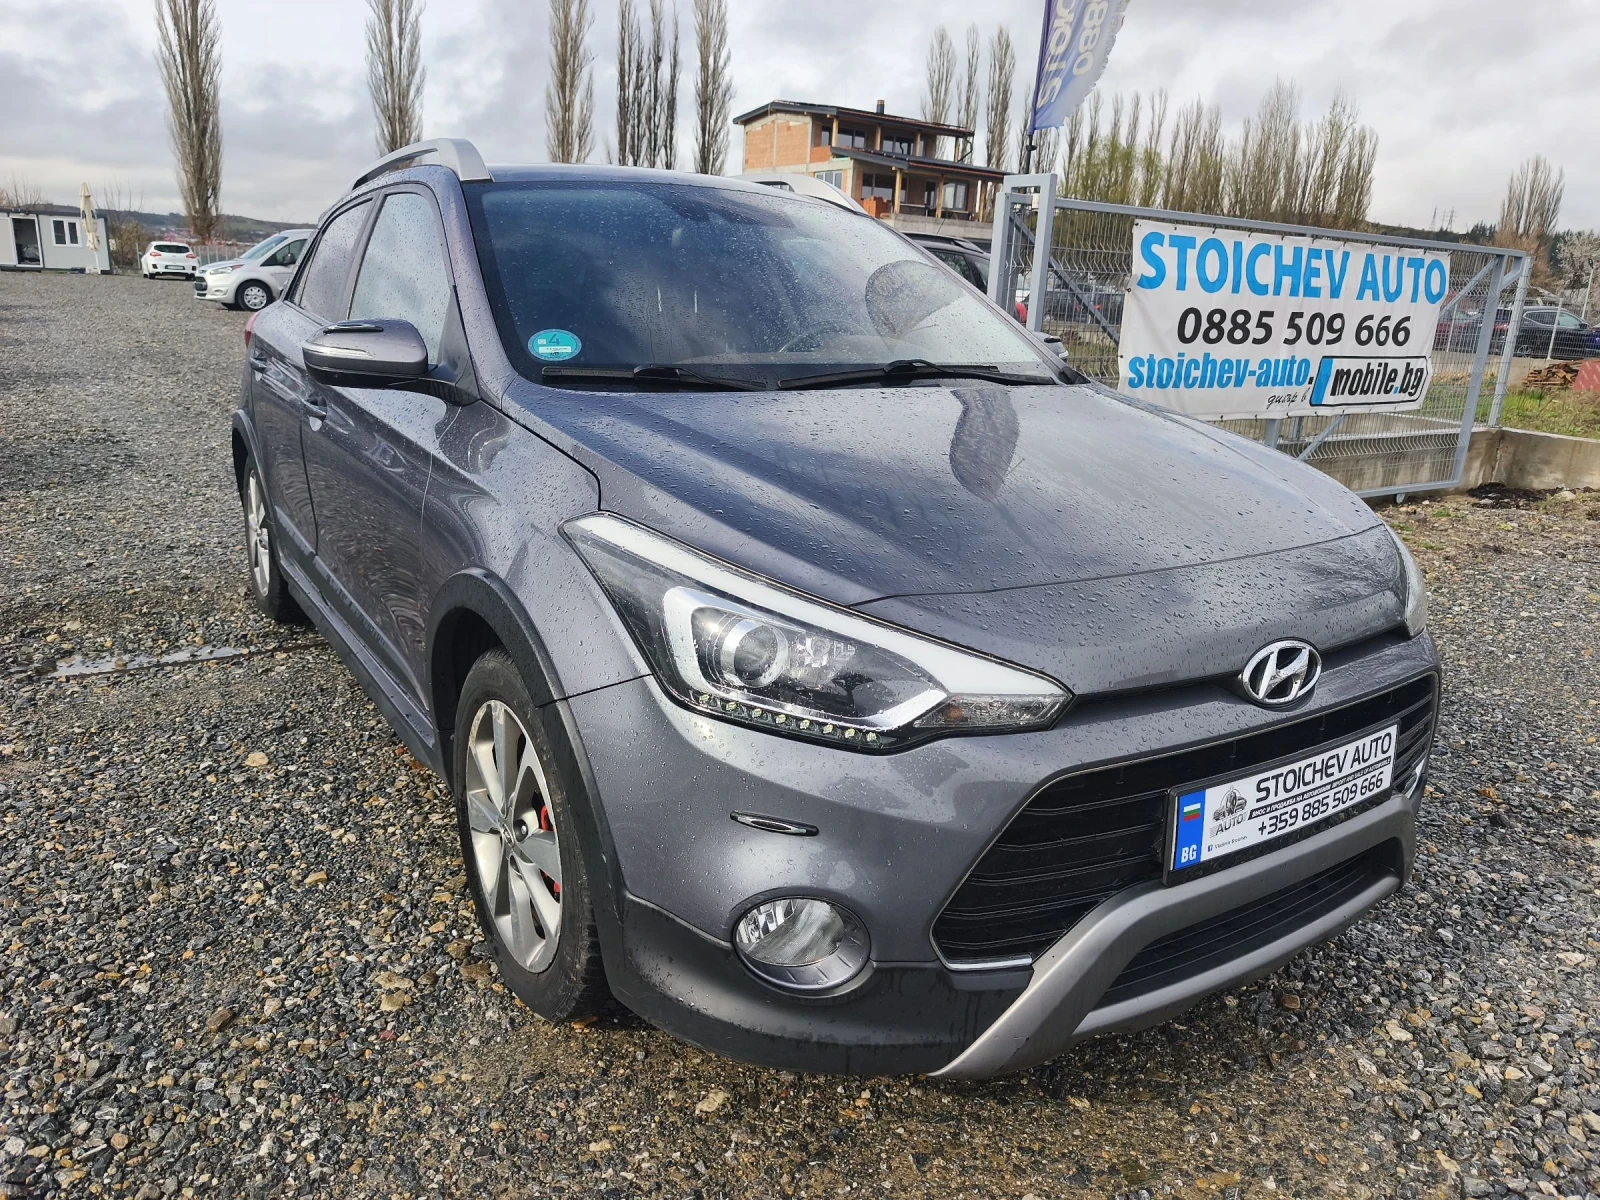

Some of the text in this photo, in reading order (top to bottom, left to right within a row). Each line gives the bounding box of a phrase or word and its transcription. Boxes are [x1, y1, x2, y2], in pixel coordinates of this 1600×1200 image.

[1073, 0, 1108, 76] 088
[1137, 231, 1447, 305] STOICHEV AUTO
[548, 333, 561, 345] 4
[1177, 307, 1411, 346] 0885 509 666
[1329, 362, 1425, 396] mobile.bg
[1255, 732, 1392, 804] STOICHEV AUTO
[1258, 771, 1384, 836] +359 885 509 666
[1215, 813, 1244, 836] AUTO
[1181, 844, 1198, 863] BG
